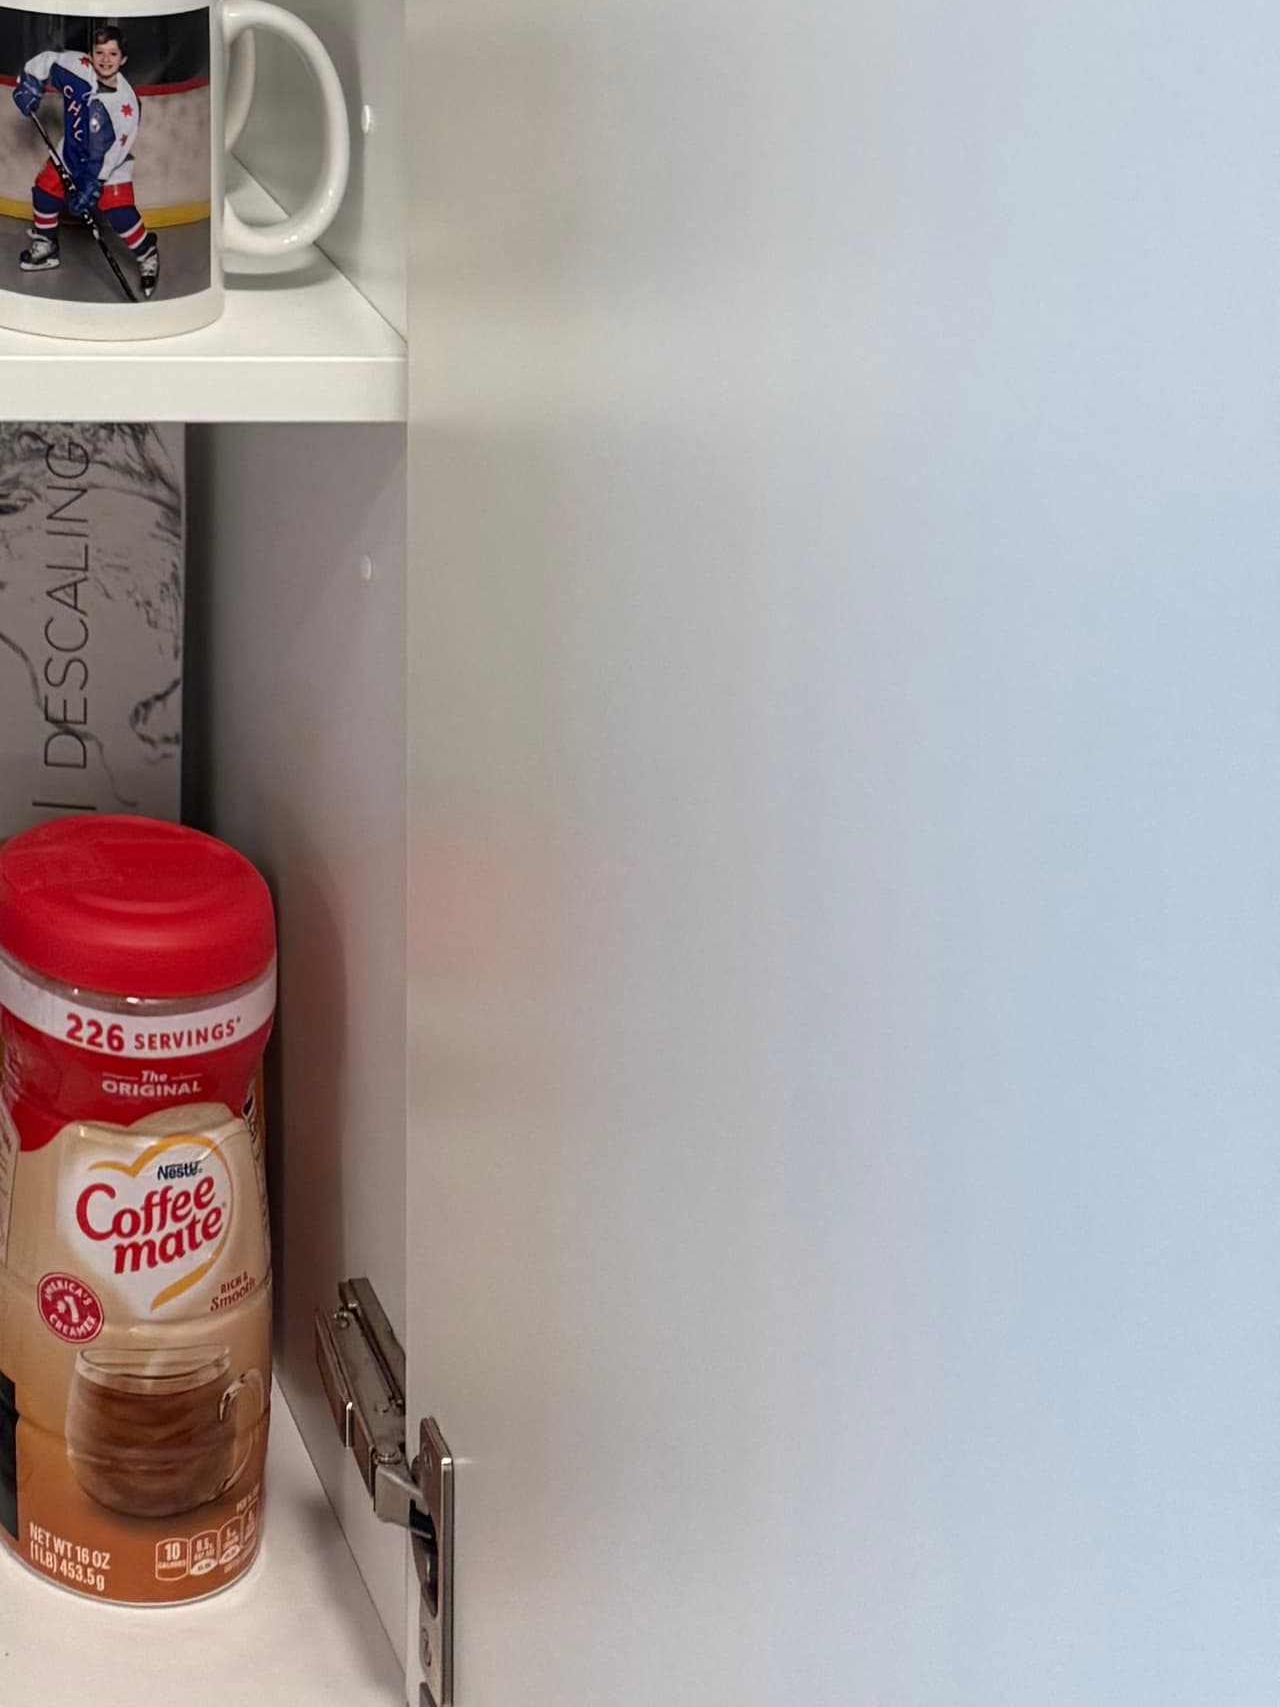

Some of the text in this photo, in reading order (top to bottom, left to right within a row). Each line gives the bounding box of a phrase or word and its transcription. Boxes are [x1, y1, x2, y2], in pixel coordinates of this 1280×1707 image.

[43, 440, 92, 771] DESCALING
[65, 1012, 126, 1053] 226
[101, 1080, 203, 1098] ORIGINAL
[140, 1069, 168, 1083] The
[75, 1175, 215, 1242] Coffee
[113, 1206, 224, 1275] mate
[48, 1312, 98, 1339] CREAMER
[29, 1521, 111, 1570] NET WT 16 OZ
[164, 1541, 180, 1562] 10
